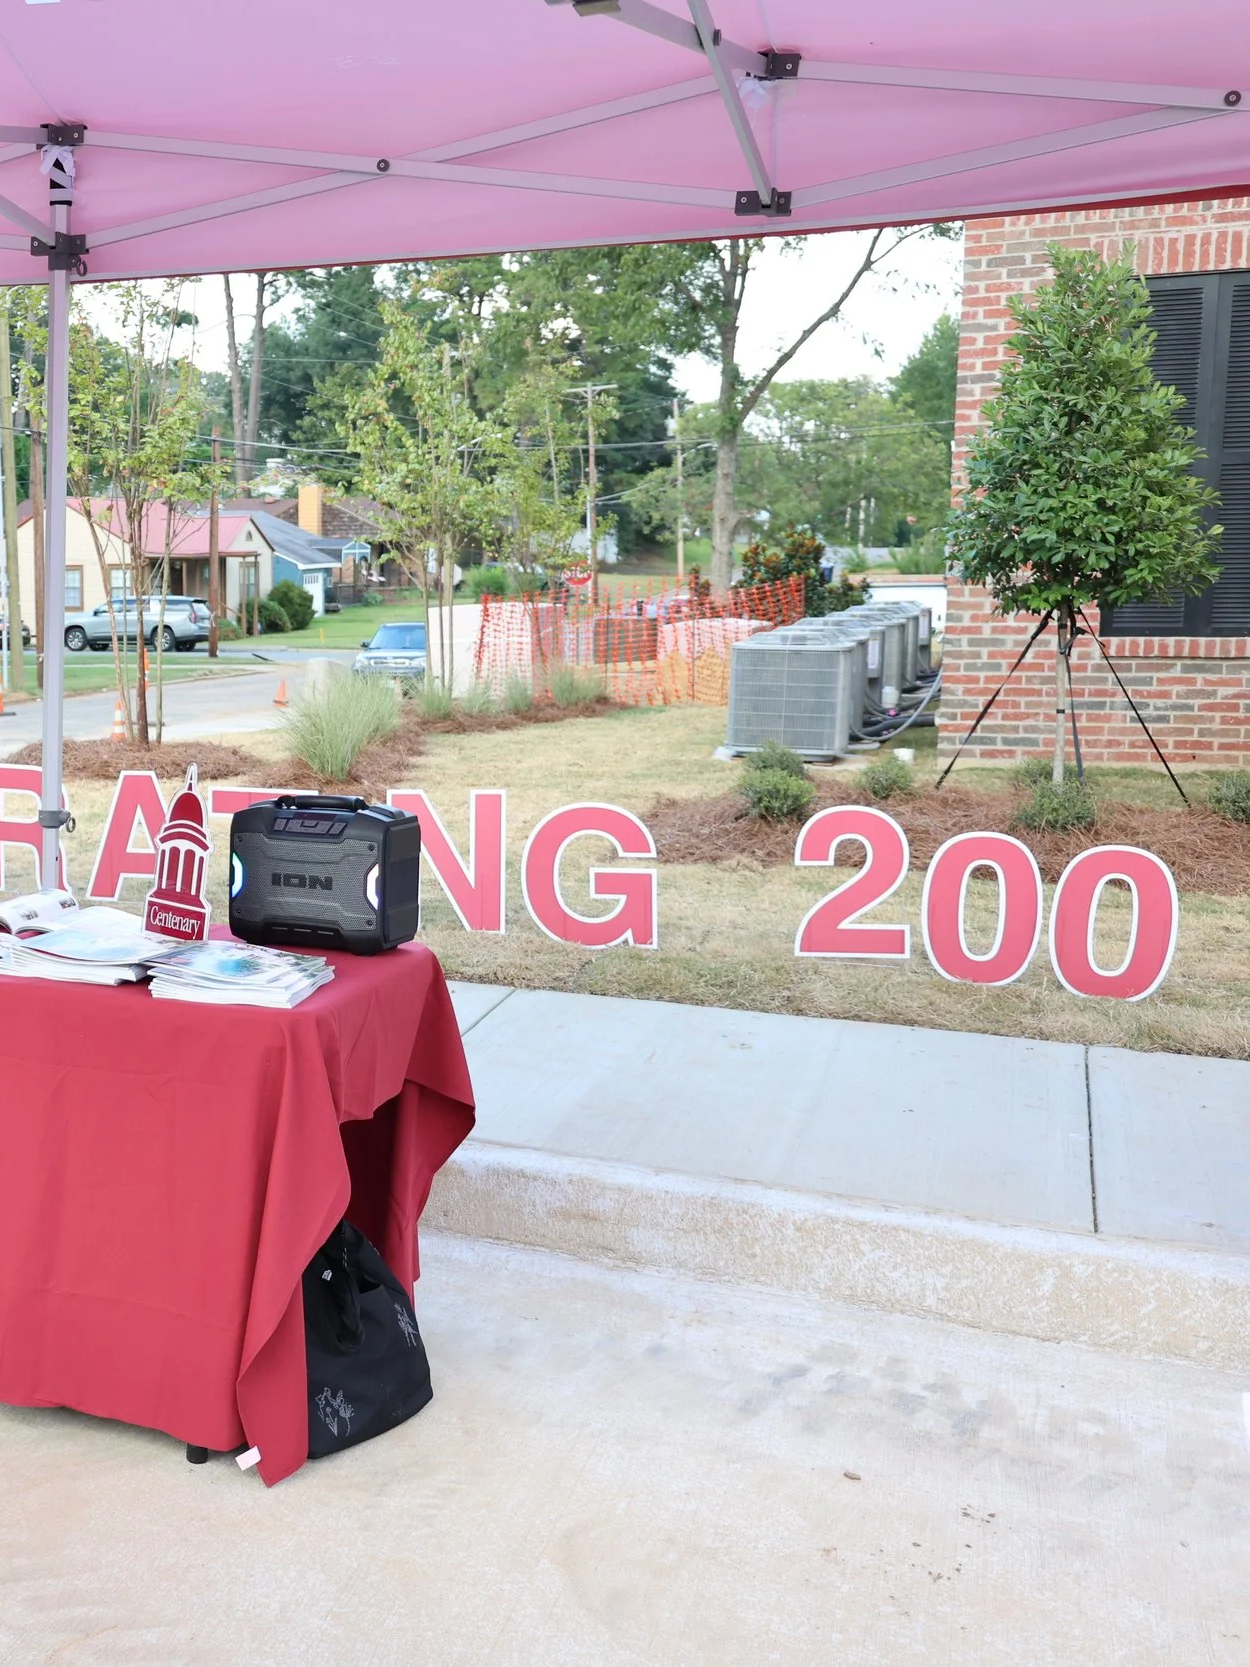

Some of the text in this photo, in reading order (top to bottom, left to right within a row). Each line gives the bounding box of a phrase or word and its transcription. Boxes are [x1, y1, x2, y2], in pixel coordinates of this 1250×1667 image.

[271, 872, 333, 890] ION
[793, 805, 1180, 1003] 200
[150, 905, 200, 939] Centenary
